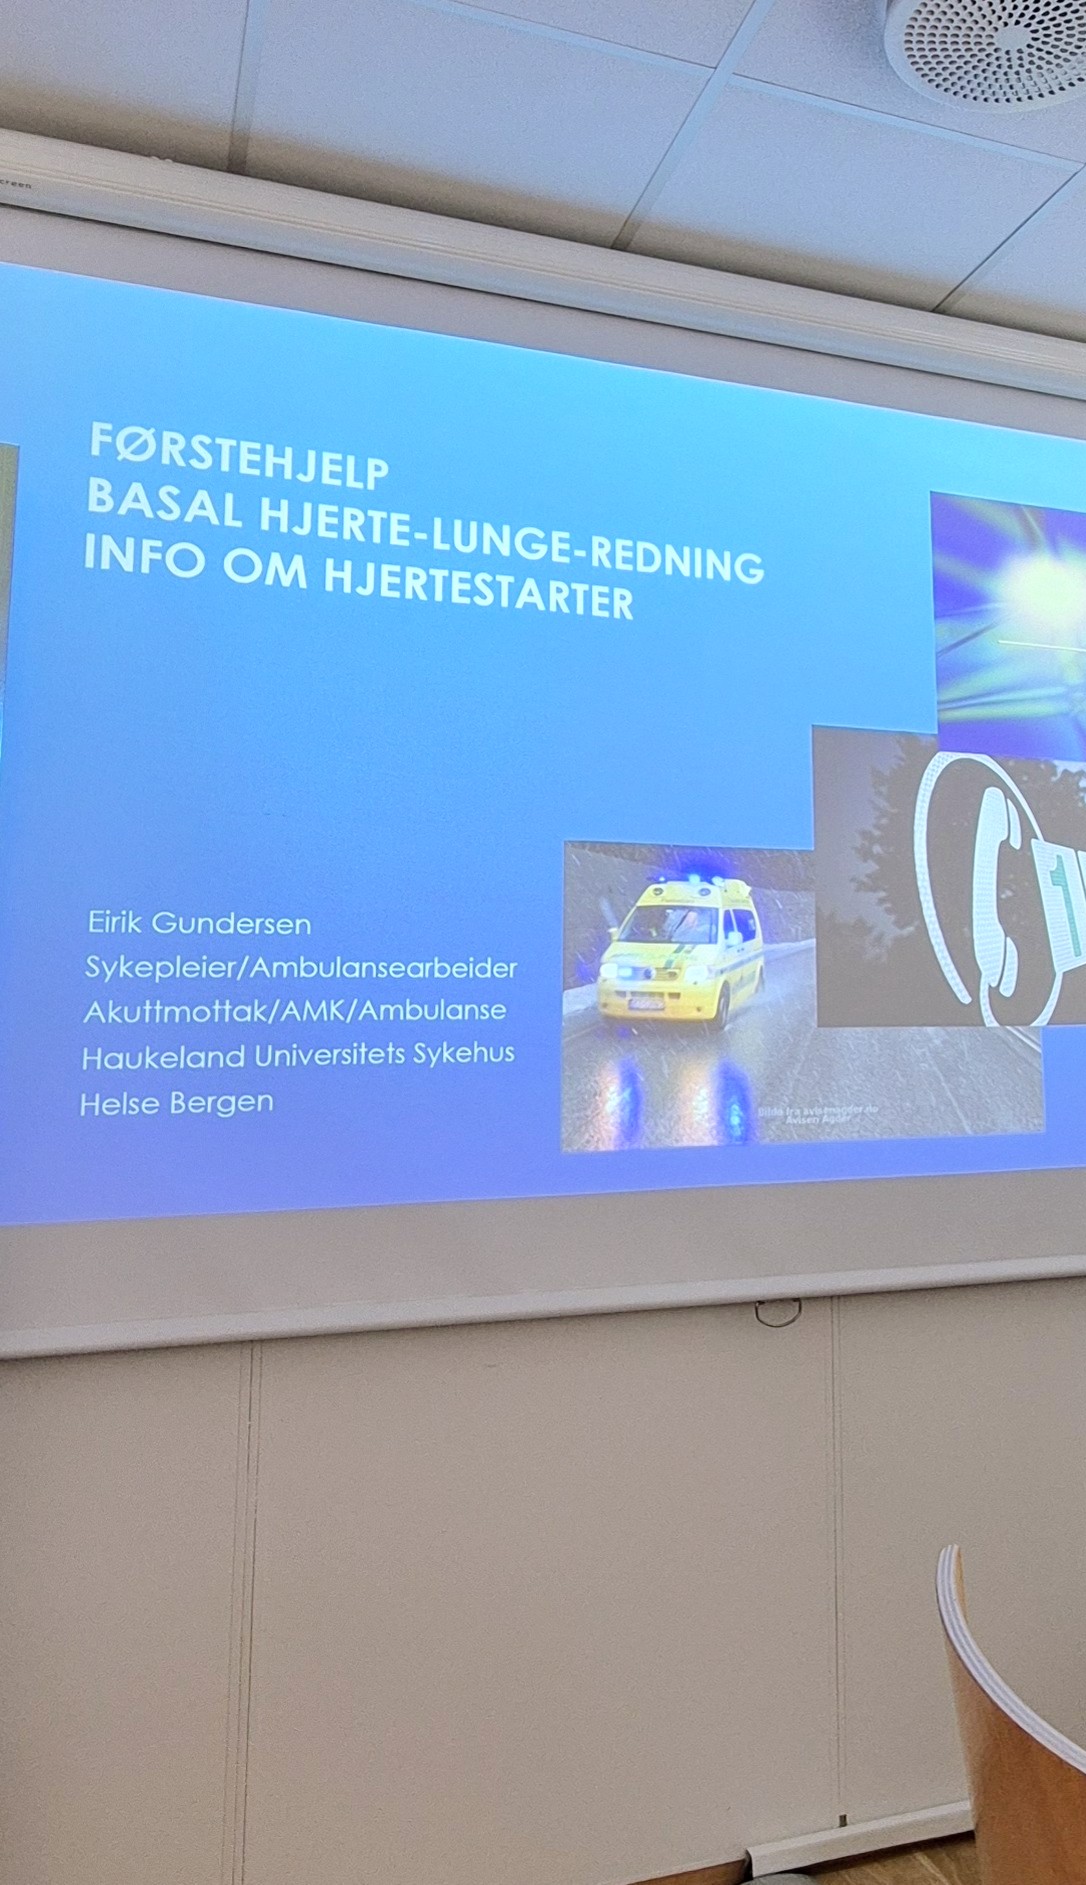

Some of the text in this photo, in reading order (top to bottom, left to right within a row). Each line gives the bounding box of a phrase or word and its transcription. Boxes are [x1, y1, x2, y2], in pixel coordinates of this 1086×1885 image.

[89, 420, 390, 491] FØRSTEHJELP
[87, 476, 766, 586] BASAL HJERTE-LUNGE-REDNING
[83, 533, 635, 621] INFO OM HJERTESTARTER
[88, 909, 312, 936] Eirik Gundersen
[84, 954, 518, 982] Sykepleier/Ambulansearbeider
[82, 998, 508, 1025] Akuttmottak/AMK/Ambulanse
[82, 1040, 516, 1071] Haukeland Universitets Sykehus
[79, 1091, 274, 1119] Helse Bergen
